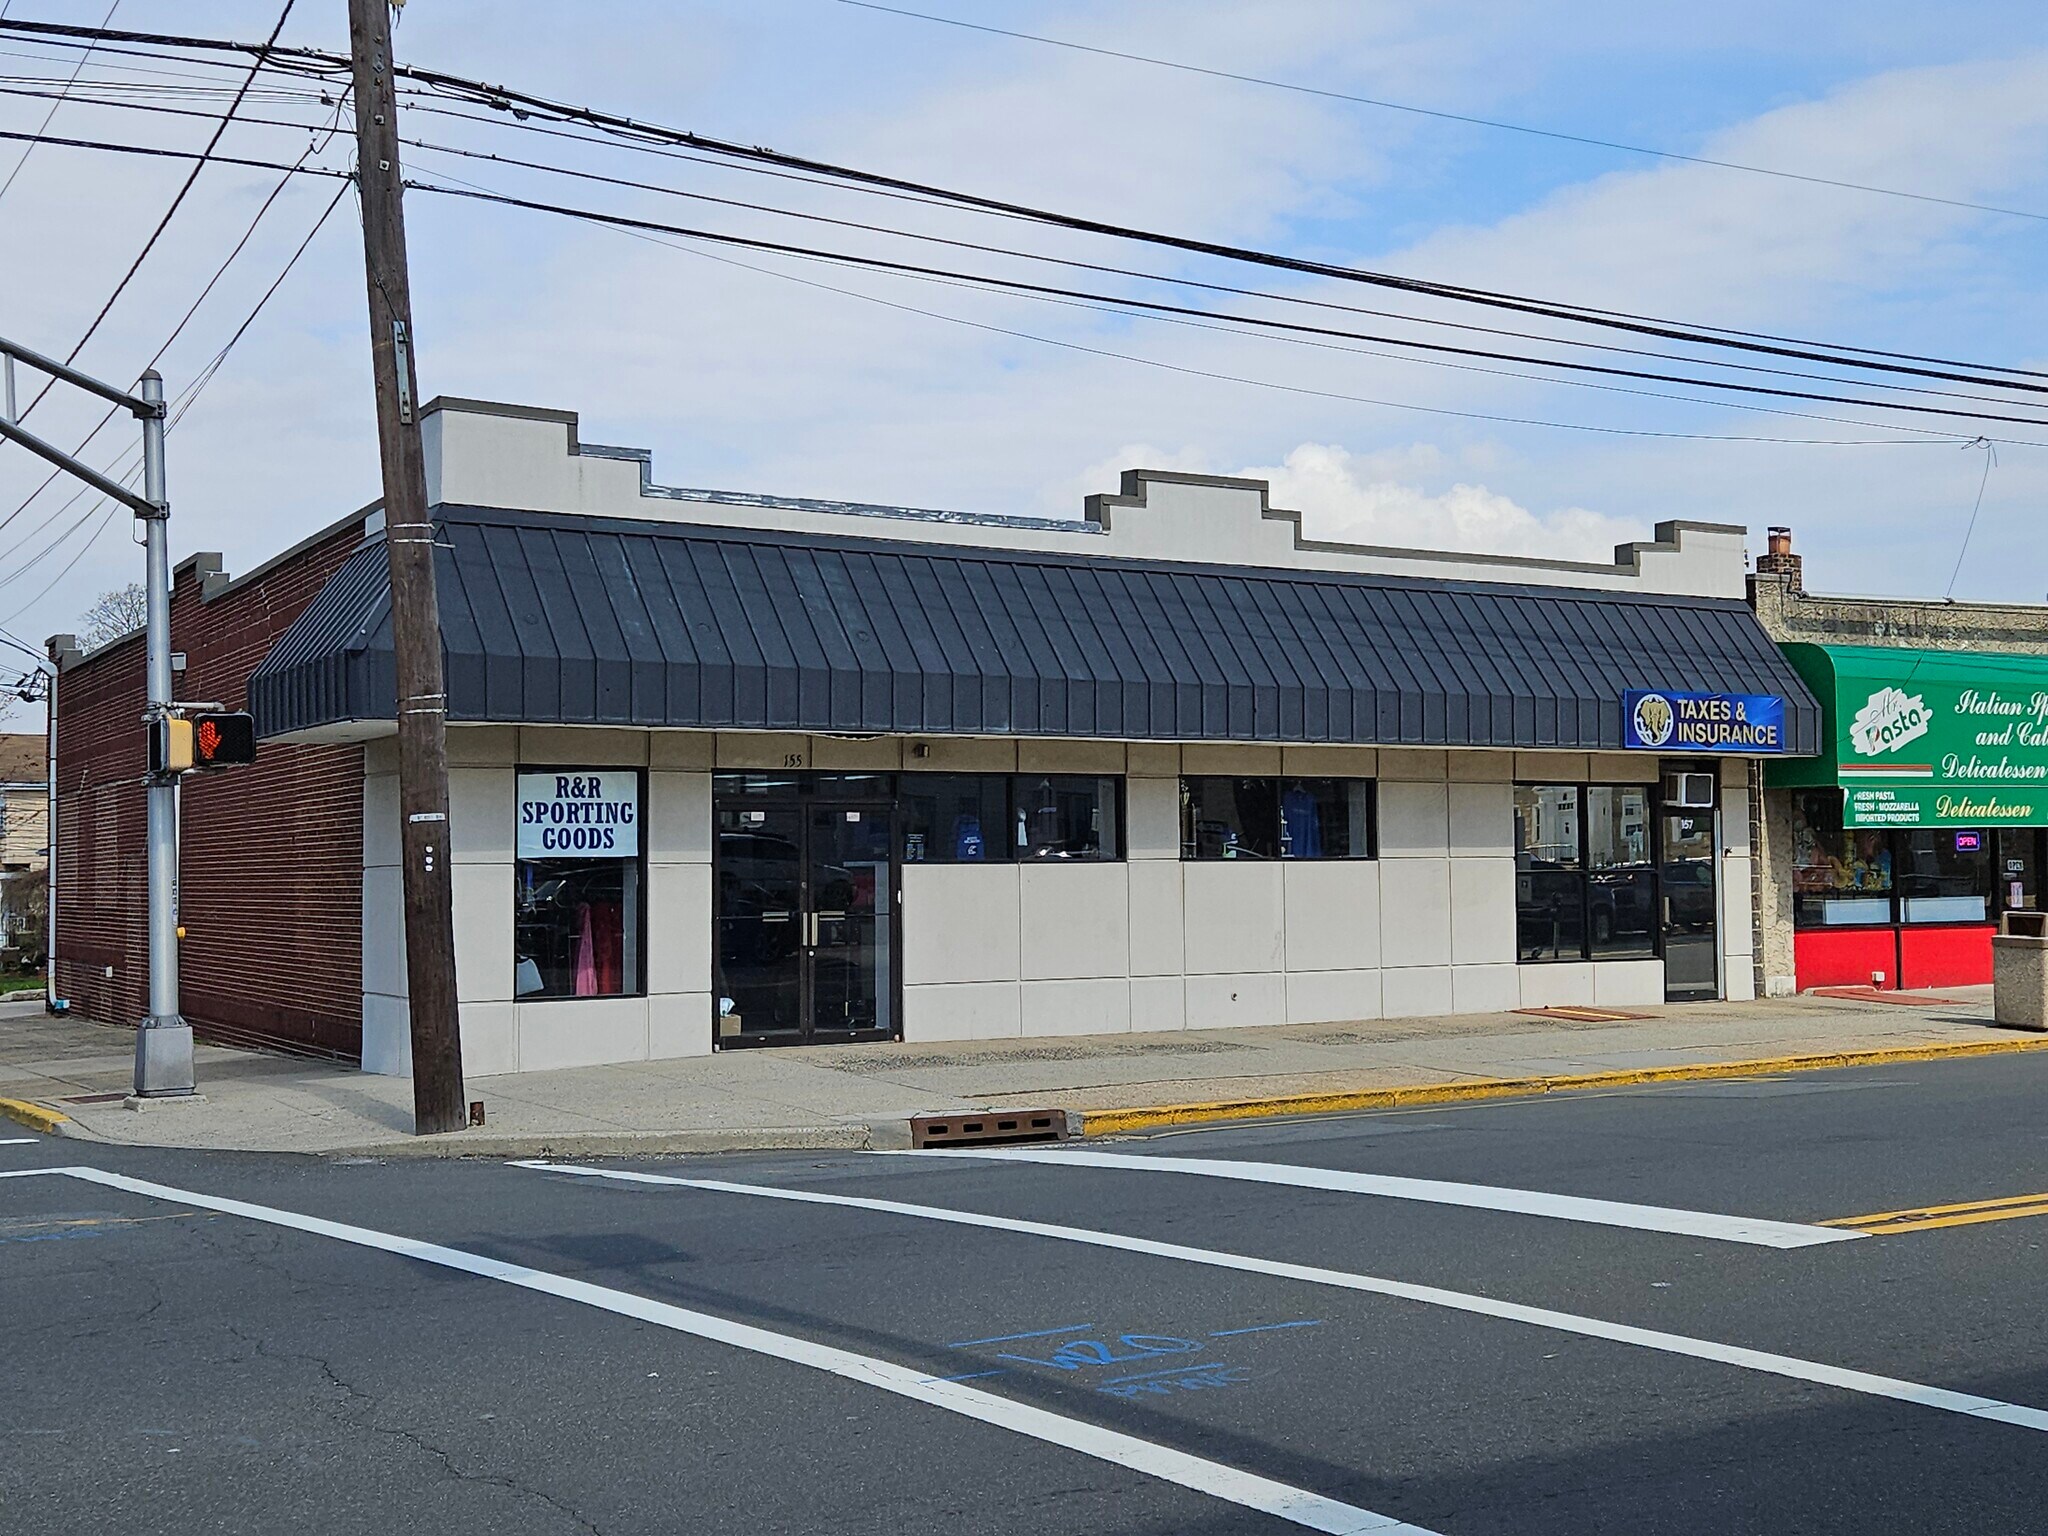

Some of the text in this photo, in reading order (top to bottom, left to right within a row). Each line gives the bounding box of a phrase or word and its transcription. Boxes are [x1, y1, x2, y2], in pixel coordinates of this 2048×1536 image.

[1677, 699, 1747, 721] TAXES &
[1954, 689, 2026, 716] Italian
[1677, 722, 1778, 745] INSURANCE
[1865, 708, 1922, 753] Pasta
[1975, 723, 2014, 746] and
[784, 754, 802, 768] 155
[1941, 752, 2048, 779] Delicatessen
[555, 776, 602, 799] R&R
[1875, 791, 1896, 801] PASTA
[522, 801, 634, 824] SPORTING
[1854, 802, 1875, 811] FRESH
[1878, 801, 1920, 811] MOZZARELLA
[1886, 812, 1920, 822] PRODUCTS
[1935, 794, 2035, 818] Delicatessen
[542, 827, 615, 850] GOODS
[1958, 837, 1977, 846] OPEN
